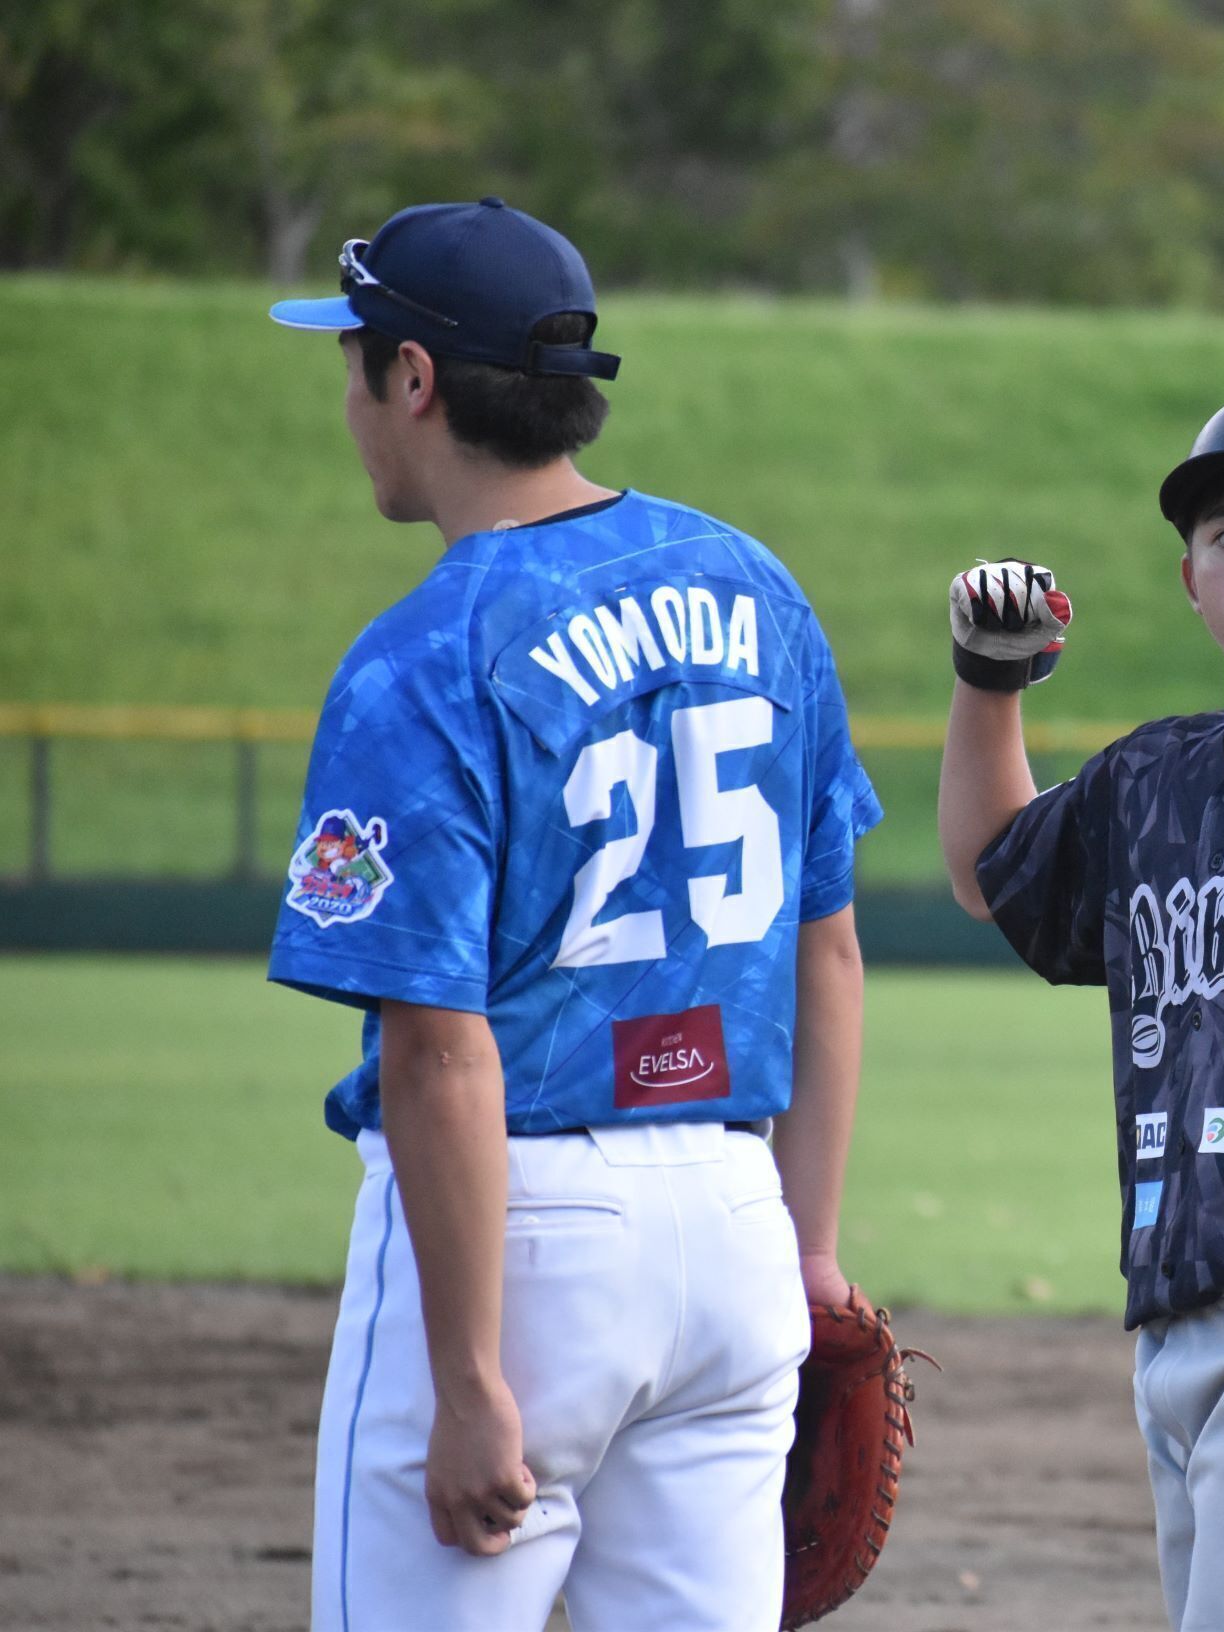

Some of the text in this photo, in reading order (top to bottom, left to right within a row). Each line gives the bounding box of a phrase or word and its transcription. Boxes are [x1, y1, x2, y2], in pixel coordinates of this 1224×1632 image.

[529, 586, 759, 706] YOMODA
[549, 696, 785, 969] 25
[307, 896, 353, 914] 2020
[639, 1048, 705, 1075] EVELSA
